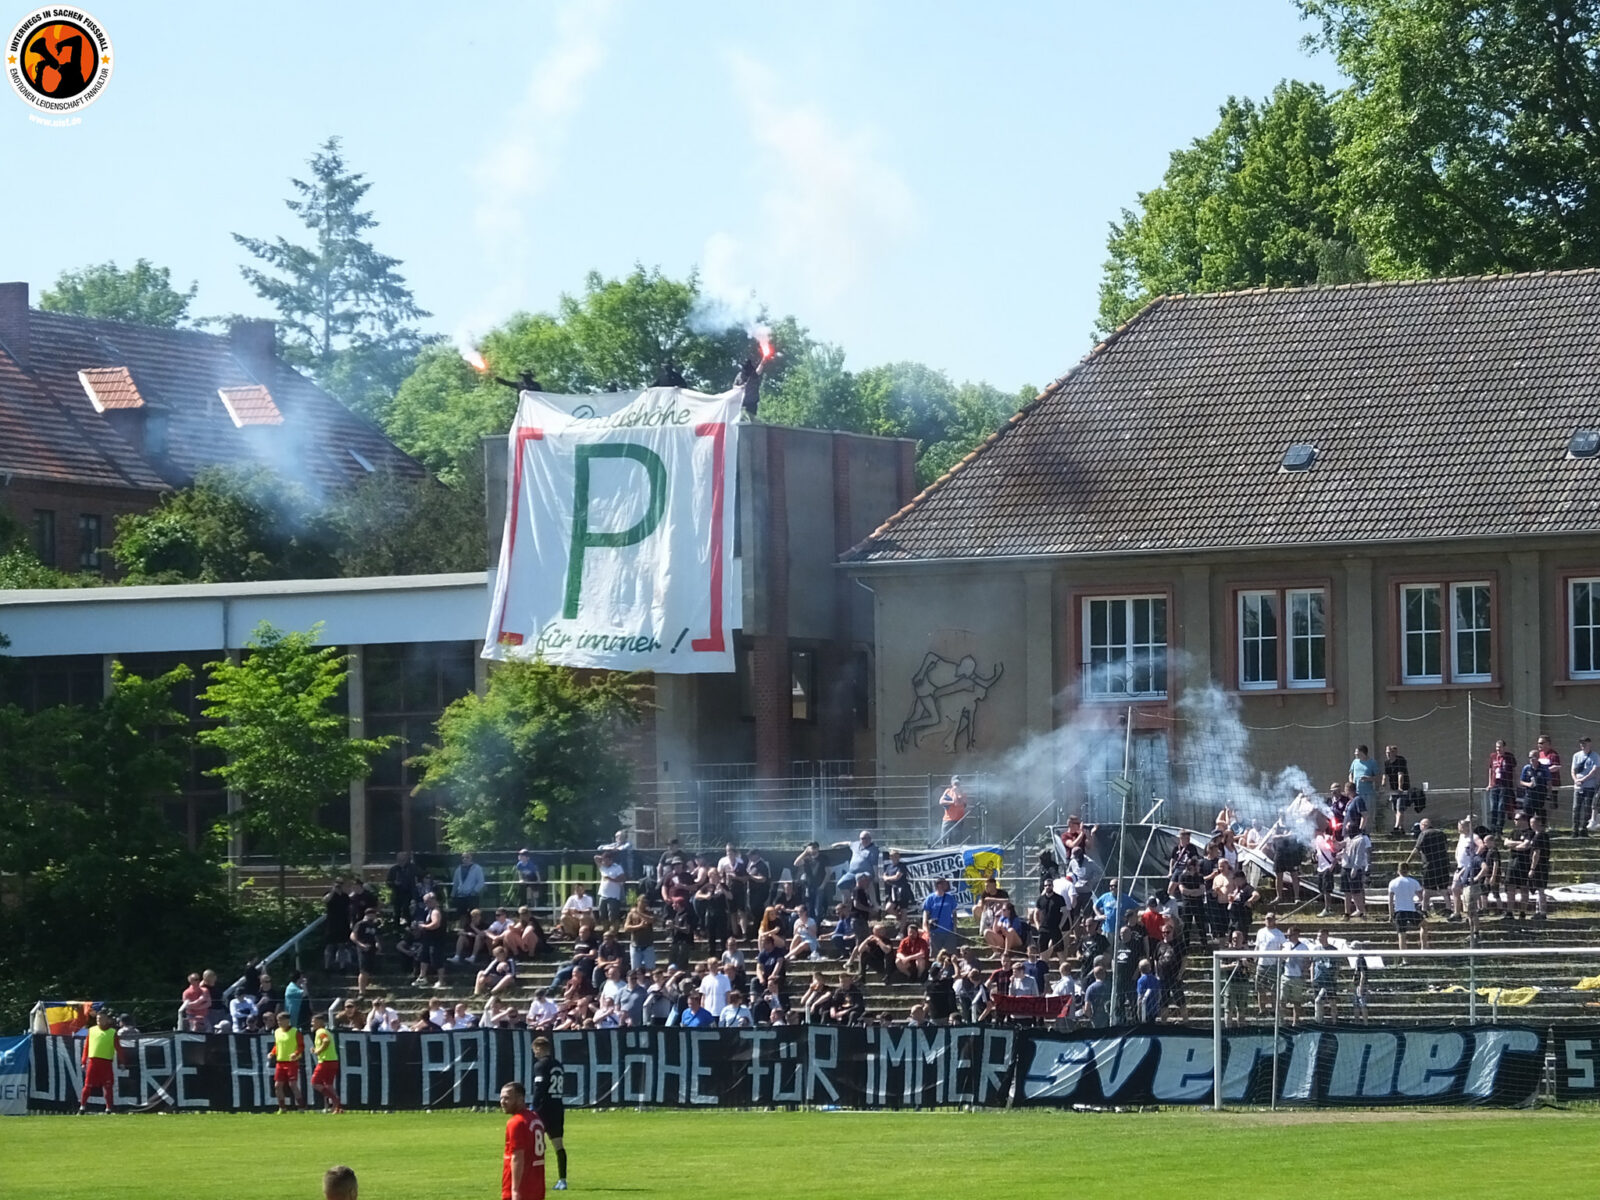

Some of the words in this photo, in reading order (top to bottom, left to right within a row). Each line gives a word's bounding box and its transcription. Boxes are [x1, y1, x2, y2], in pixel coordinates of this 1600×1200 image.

[563, 443, 667, 619] P
[536, 622, 572, 656] für
[29, 1032, 210, 1107] UNERE
[229, 1032, 397, 1107] HEAT
[548, 1074, 564, 1094] 28
[0, 1084, 26, 1099] ER
[534, 1129, 545, 1157] 8
